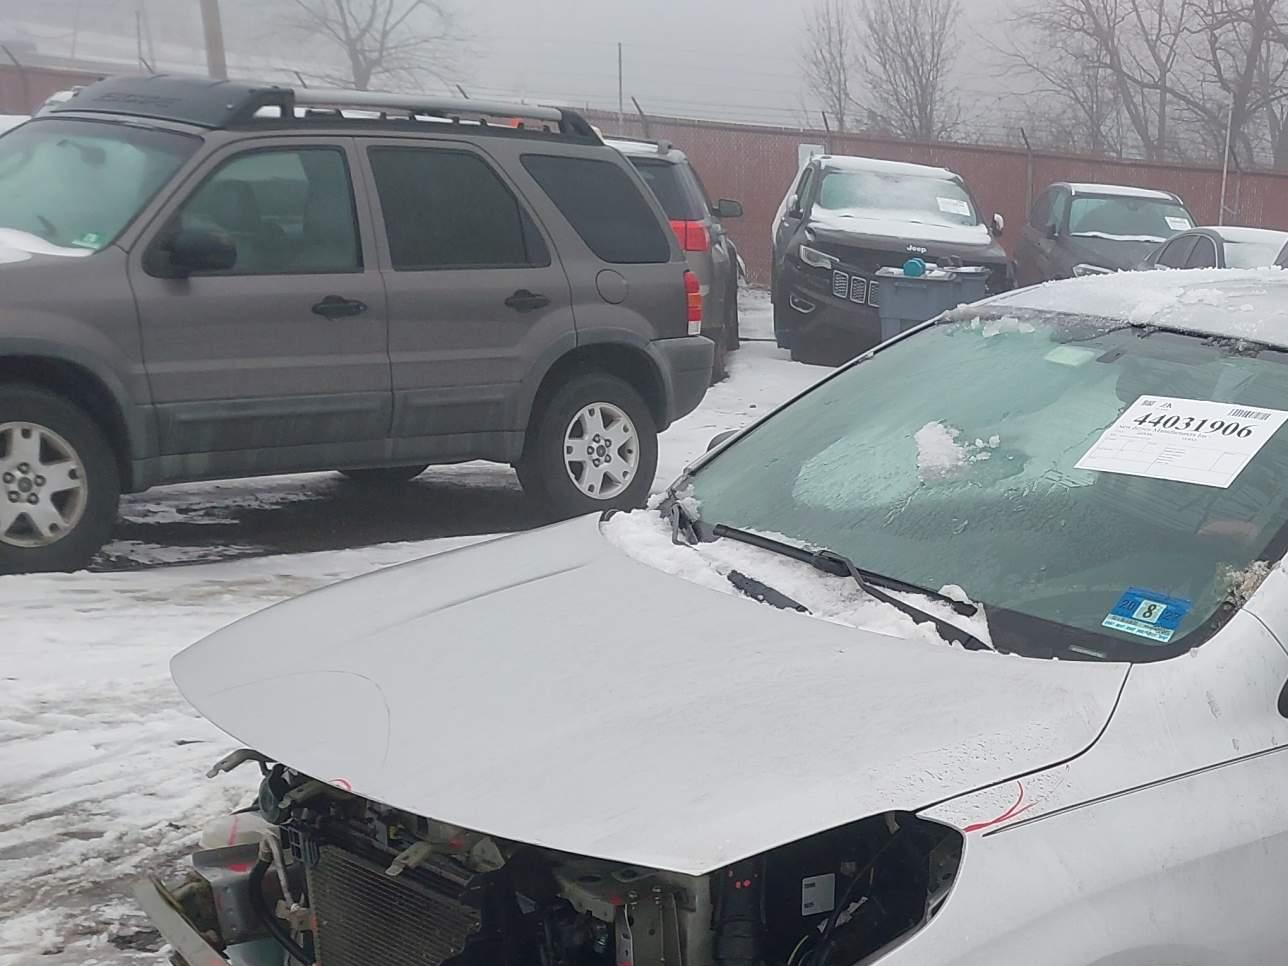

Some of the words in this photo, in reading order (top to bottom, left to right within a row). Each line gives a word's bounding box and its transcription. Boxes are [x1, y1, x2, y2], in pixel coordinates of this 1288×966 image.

[906, 244, 928, 254] Jeep
[1133, 412, 1257, 439] 44031906
[1142, 603, 1157, 619] 8
